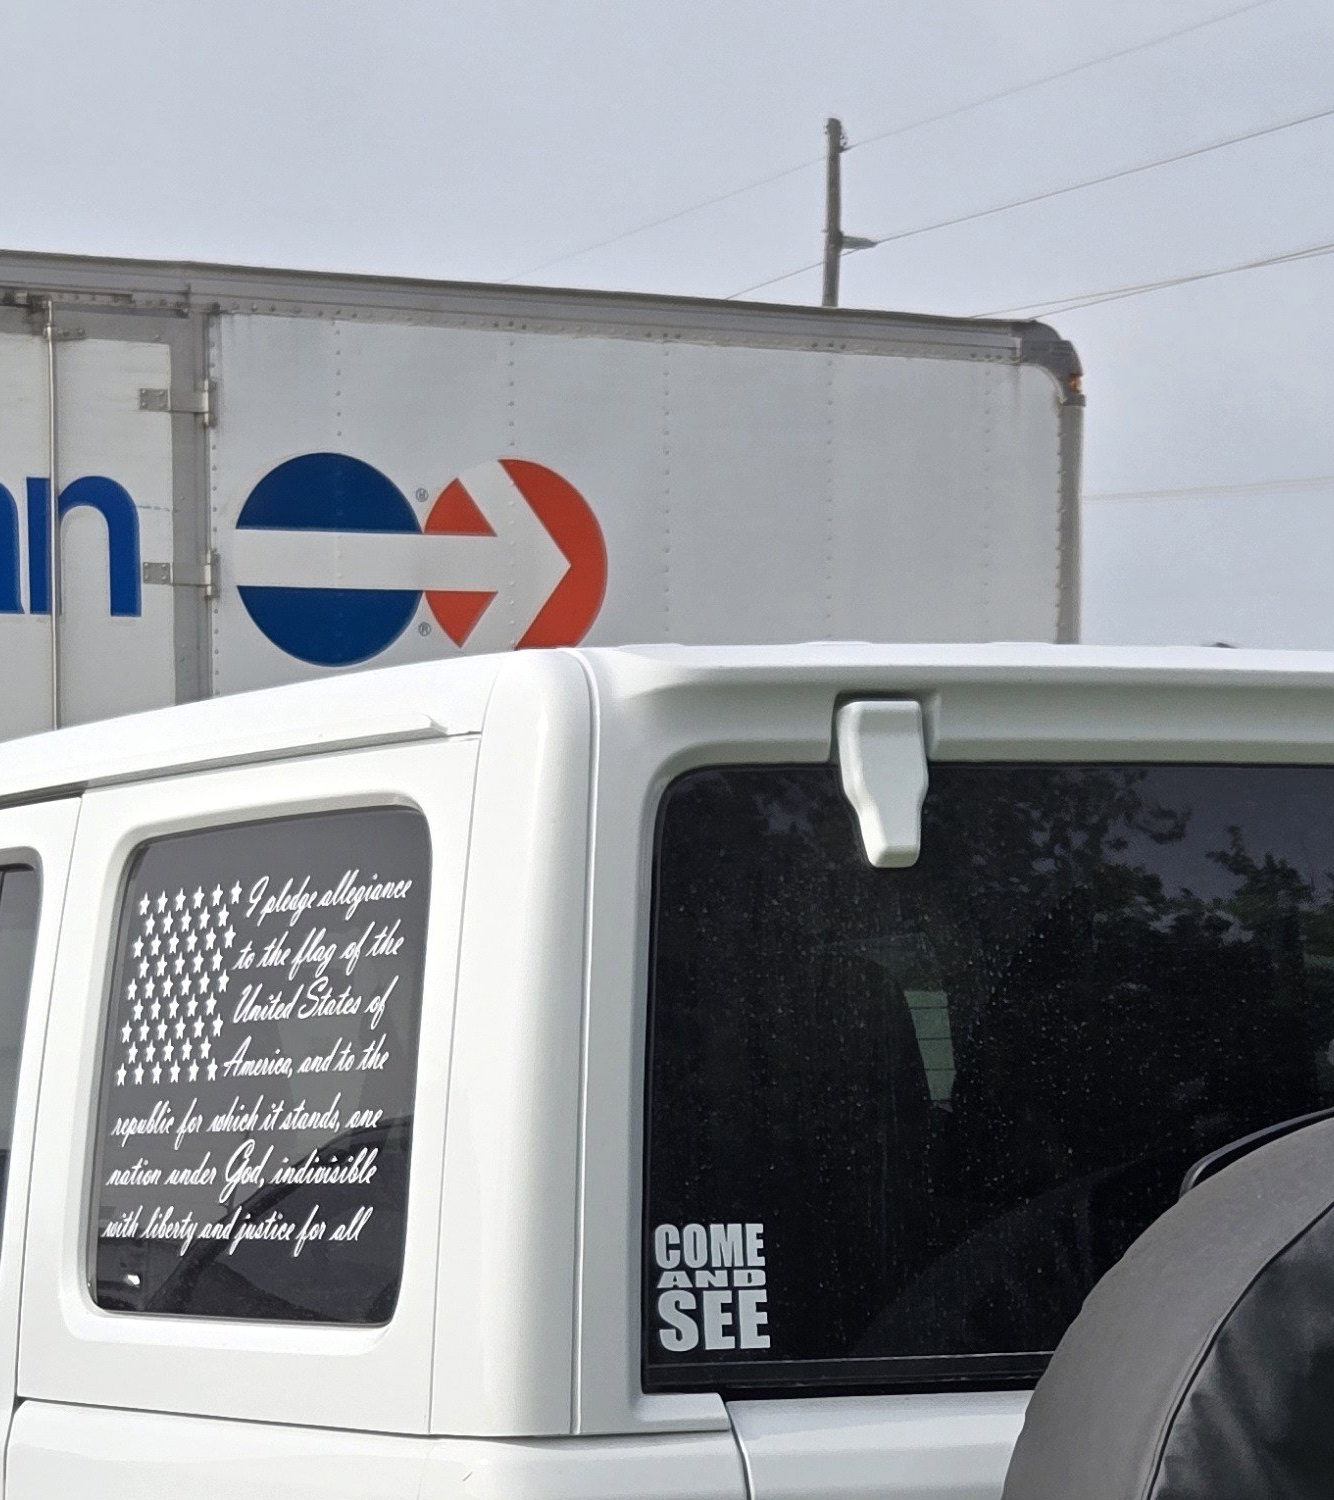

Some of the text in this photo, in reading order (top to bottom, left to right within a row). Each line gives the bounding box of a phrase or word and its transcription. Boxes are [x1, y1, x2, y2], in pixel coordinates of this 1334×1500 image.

[246, 869, 412, 927] I pledge allegiance
[231, 919, 404, 981] to the flag of the
[233, 975, 399, 1030] United States of
[224, 1033, 389, 1078] America, and to the
[110, 1092, 383, 1150] republic for which it stands, one
[106, 1139, 378, 1203] nation under God, indivisible
[101, 1204, 373, 1257] with liberty and justice for all
[655, 1223, 765, 1269] COME
[657, 1269, 766, 1288] AND
[658, 1289, 771, 1351] SEE
